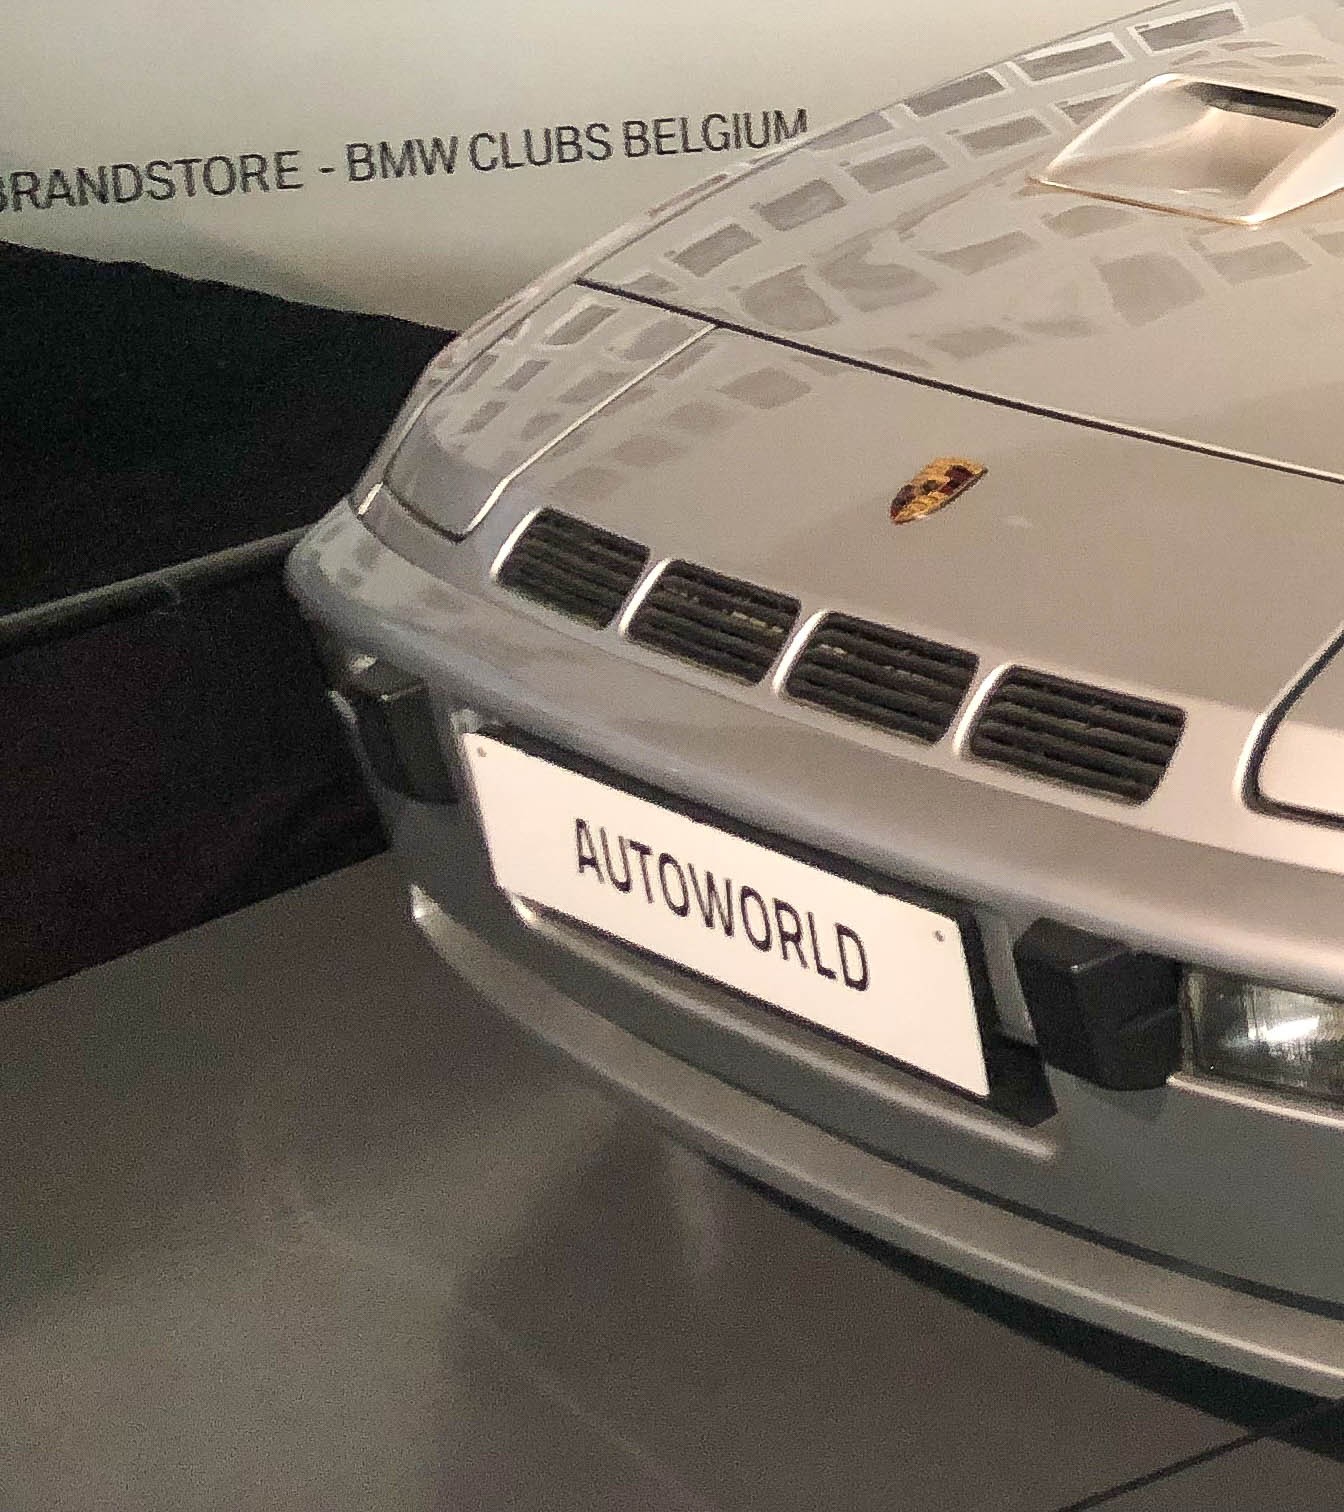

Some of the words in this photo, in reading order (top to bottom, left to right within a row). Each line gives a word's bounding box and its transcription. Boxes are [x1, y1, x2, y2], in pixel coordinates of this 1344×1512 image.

[0, 150, 304, 213] RANDSTORE
[346, 135, 459, 182] BMW
[468, 122, 614, 172] CLUBS
[622, 107, 808, 158] BELGIUM
[574, 817, 871, 992] AUTOWORLD
